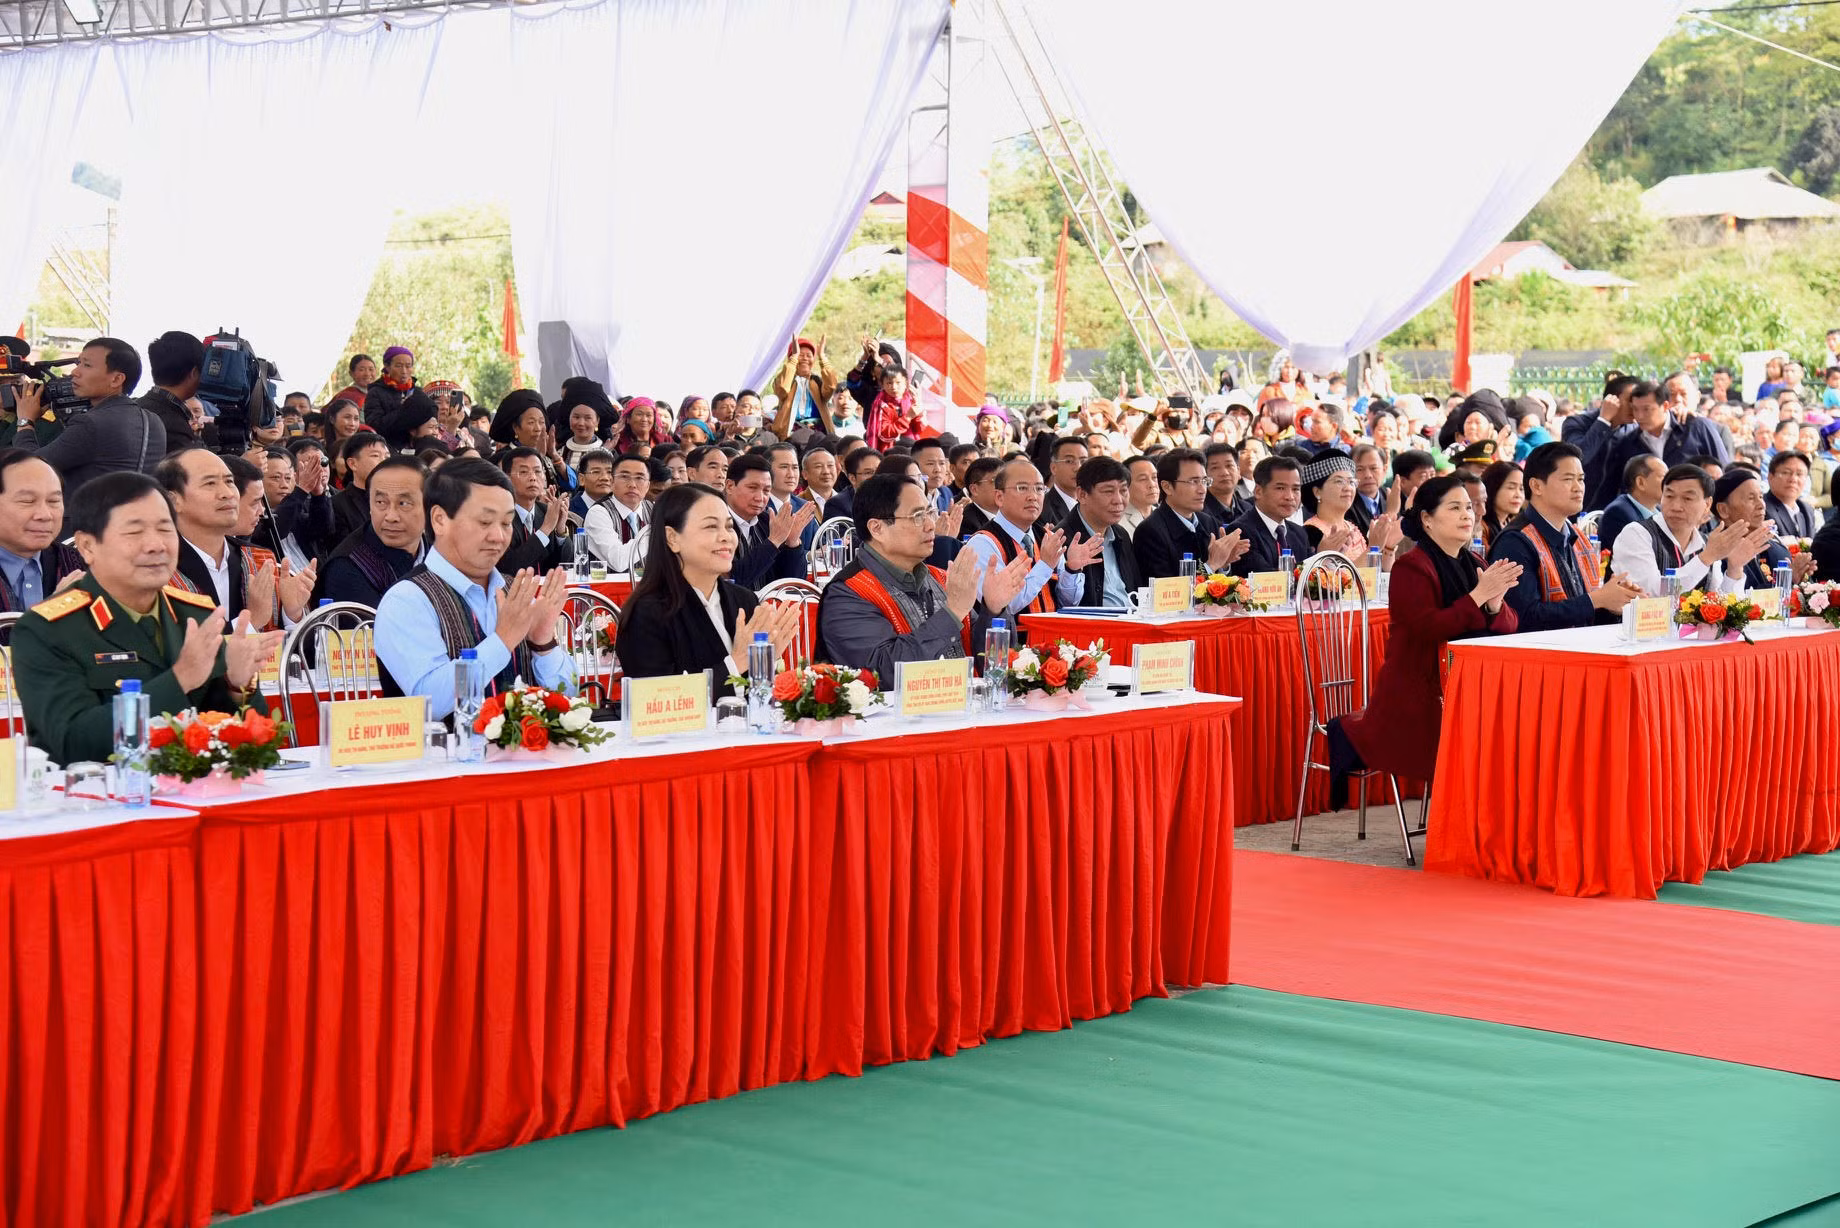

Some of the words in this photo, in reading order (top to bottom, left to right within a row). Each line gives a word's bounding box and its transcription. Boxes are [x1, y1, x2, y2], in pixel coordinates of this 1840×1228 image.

[665, 700, 671, 712] A
[349, 724, 360, 741] LÊ
[363, 725, 384, 740] HUY
[386, 722, 410, 740] VỊNH
